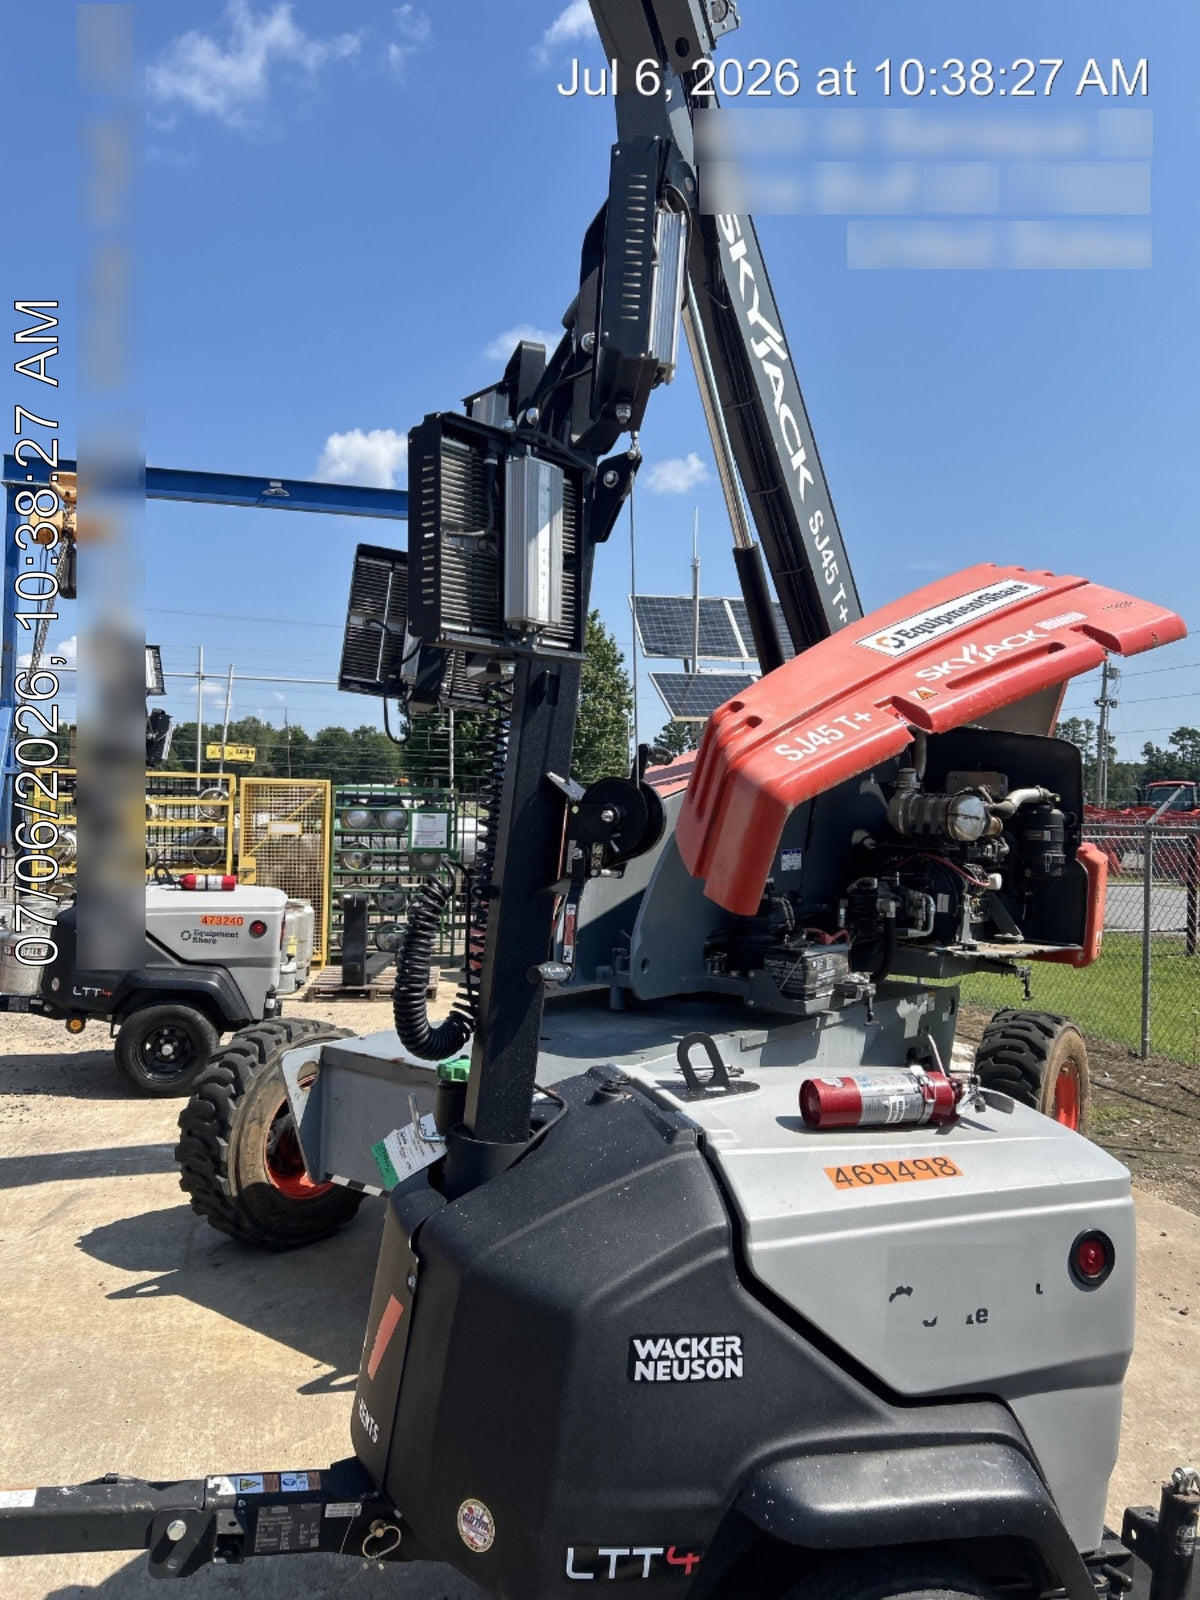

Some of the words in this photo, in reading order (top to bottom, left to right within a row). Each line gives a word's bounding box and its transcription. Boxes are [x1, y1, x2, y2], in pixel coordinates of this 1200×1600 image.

[809, 510, 839, 585] SJ45
[899, 582, 1029, 640] EquipmentShare
[915, 628, 1050, 681] SKYJACK
[775, 727, 845, 761] SJ45
[201, 916, 243, 926] 473240
[73, 986, 112, 998] LTT4
[835, 1156, 958, 1186] 469498
[633, 1336, 743, 1360] WACKER
[634, 1358, 743, 1381] NEUSON
[566, 1545, 701, 1581] LTT4
